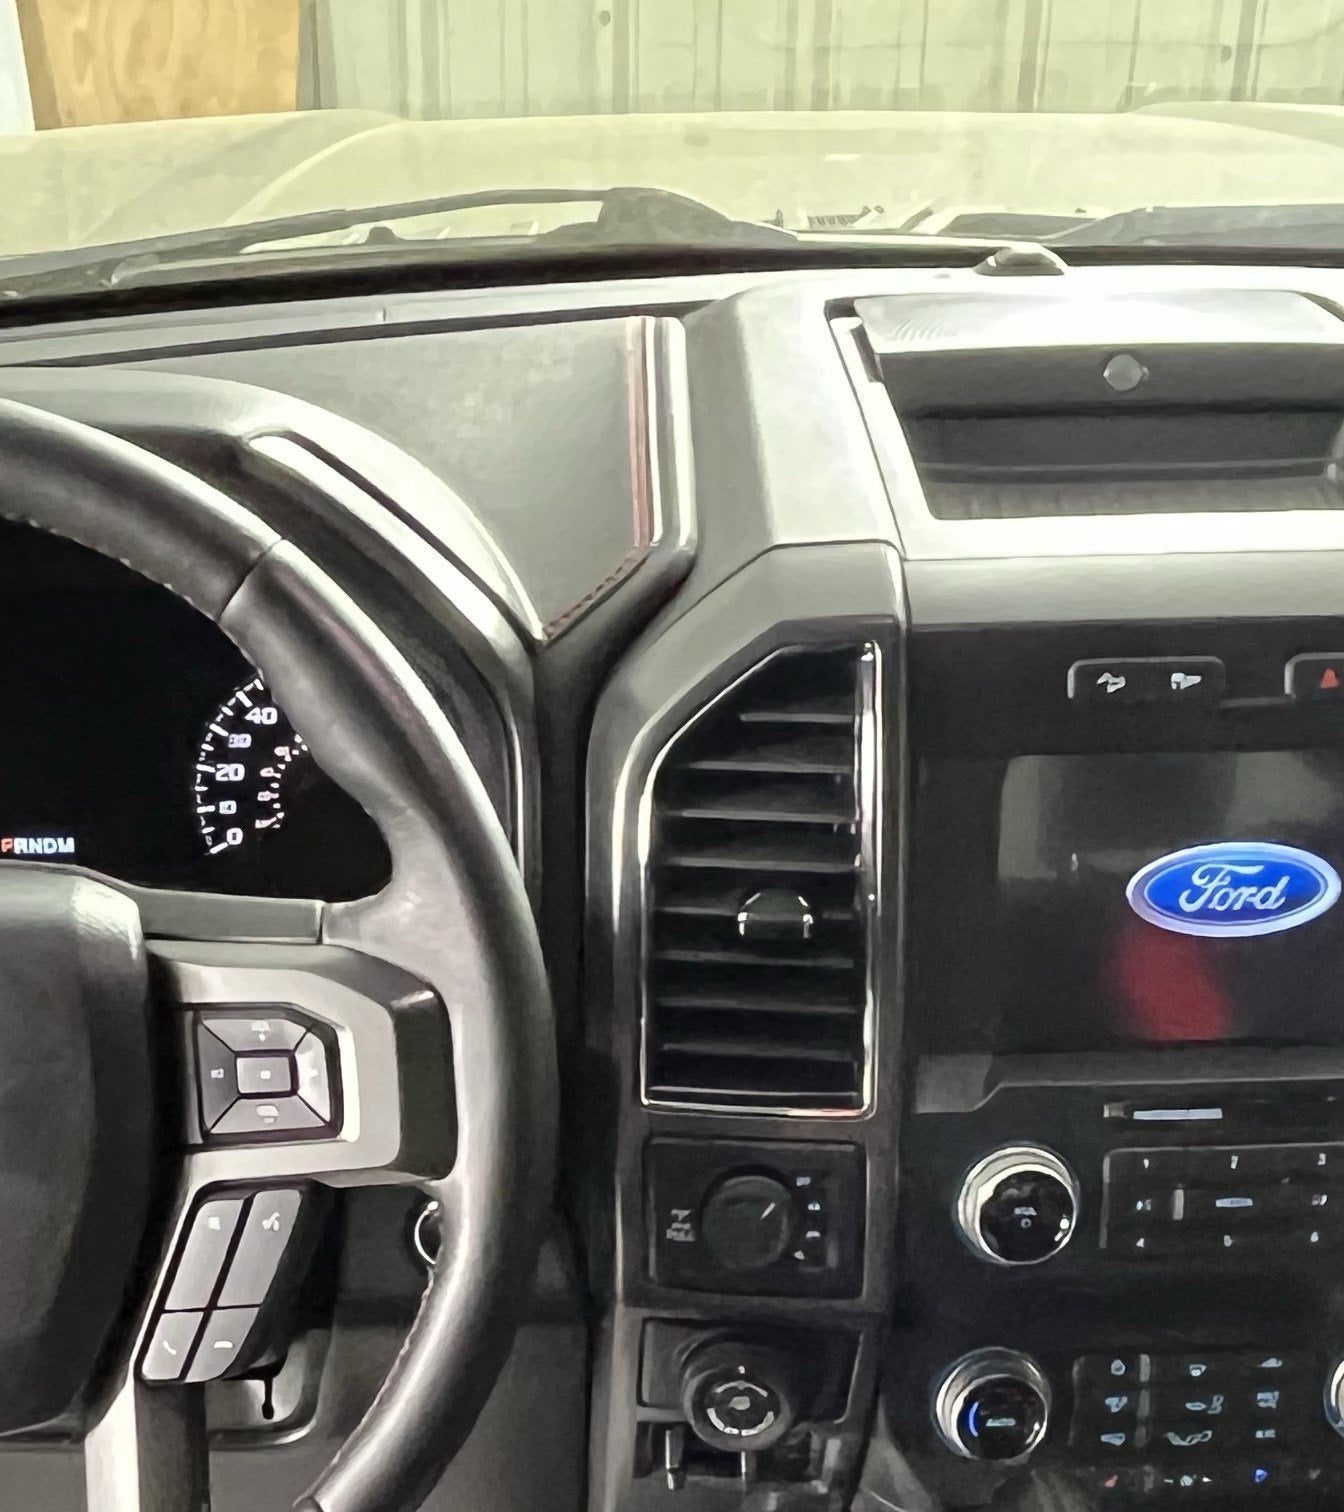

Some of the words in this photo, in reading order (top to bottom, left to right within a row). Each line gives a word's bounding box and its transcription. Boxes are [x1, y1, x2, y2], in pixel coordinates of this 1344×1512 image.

[244, 706, 278, 725] 40
[215, 763, 245, 782] 20
[1179, 864, 1289, 912] Ford
